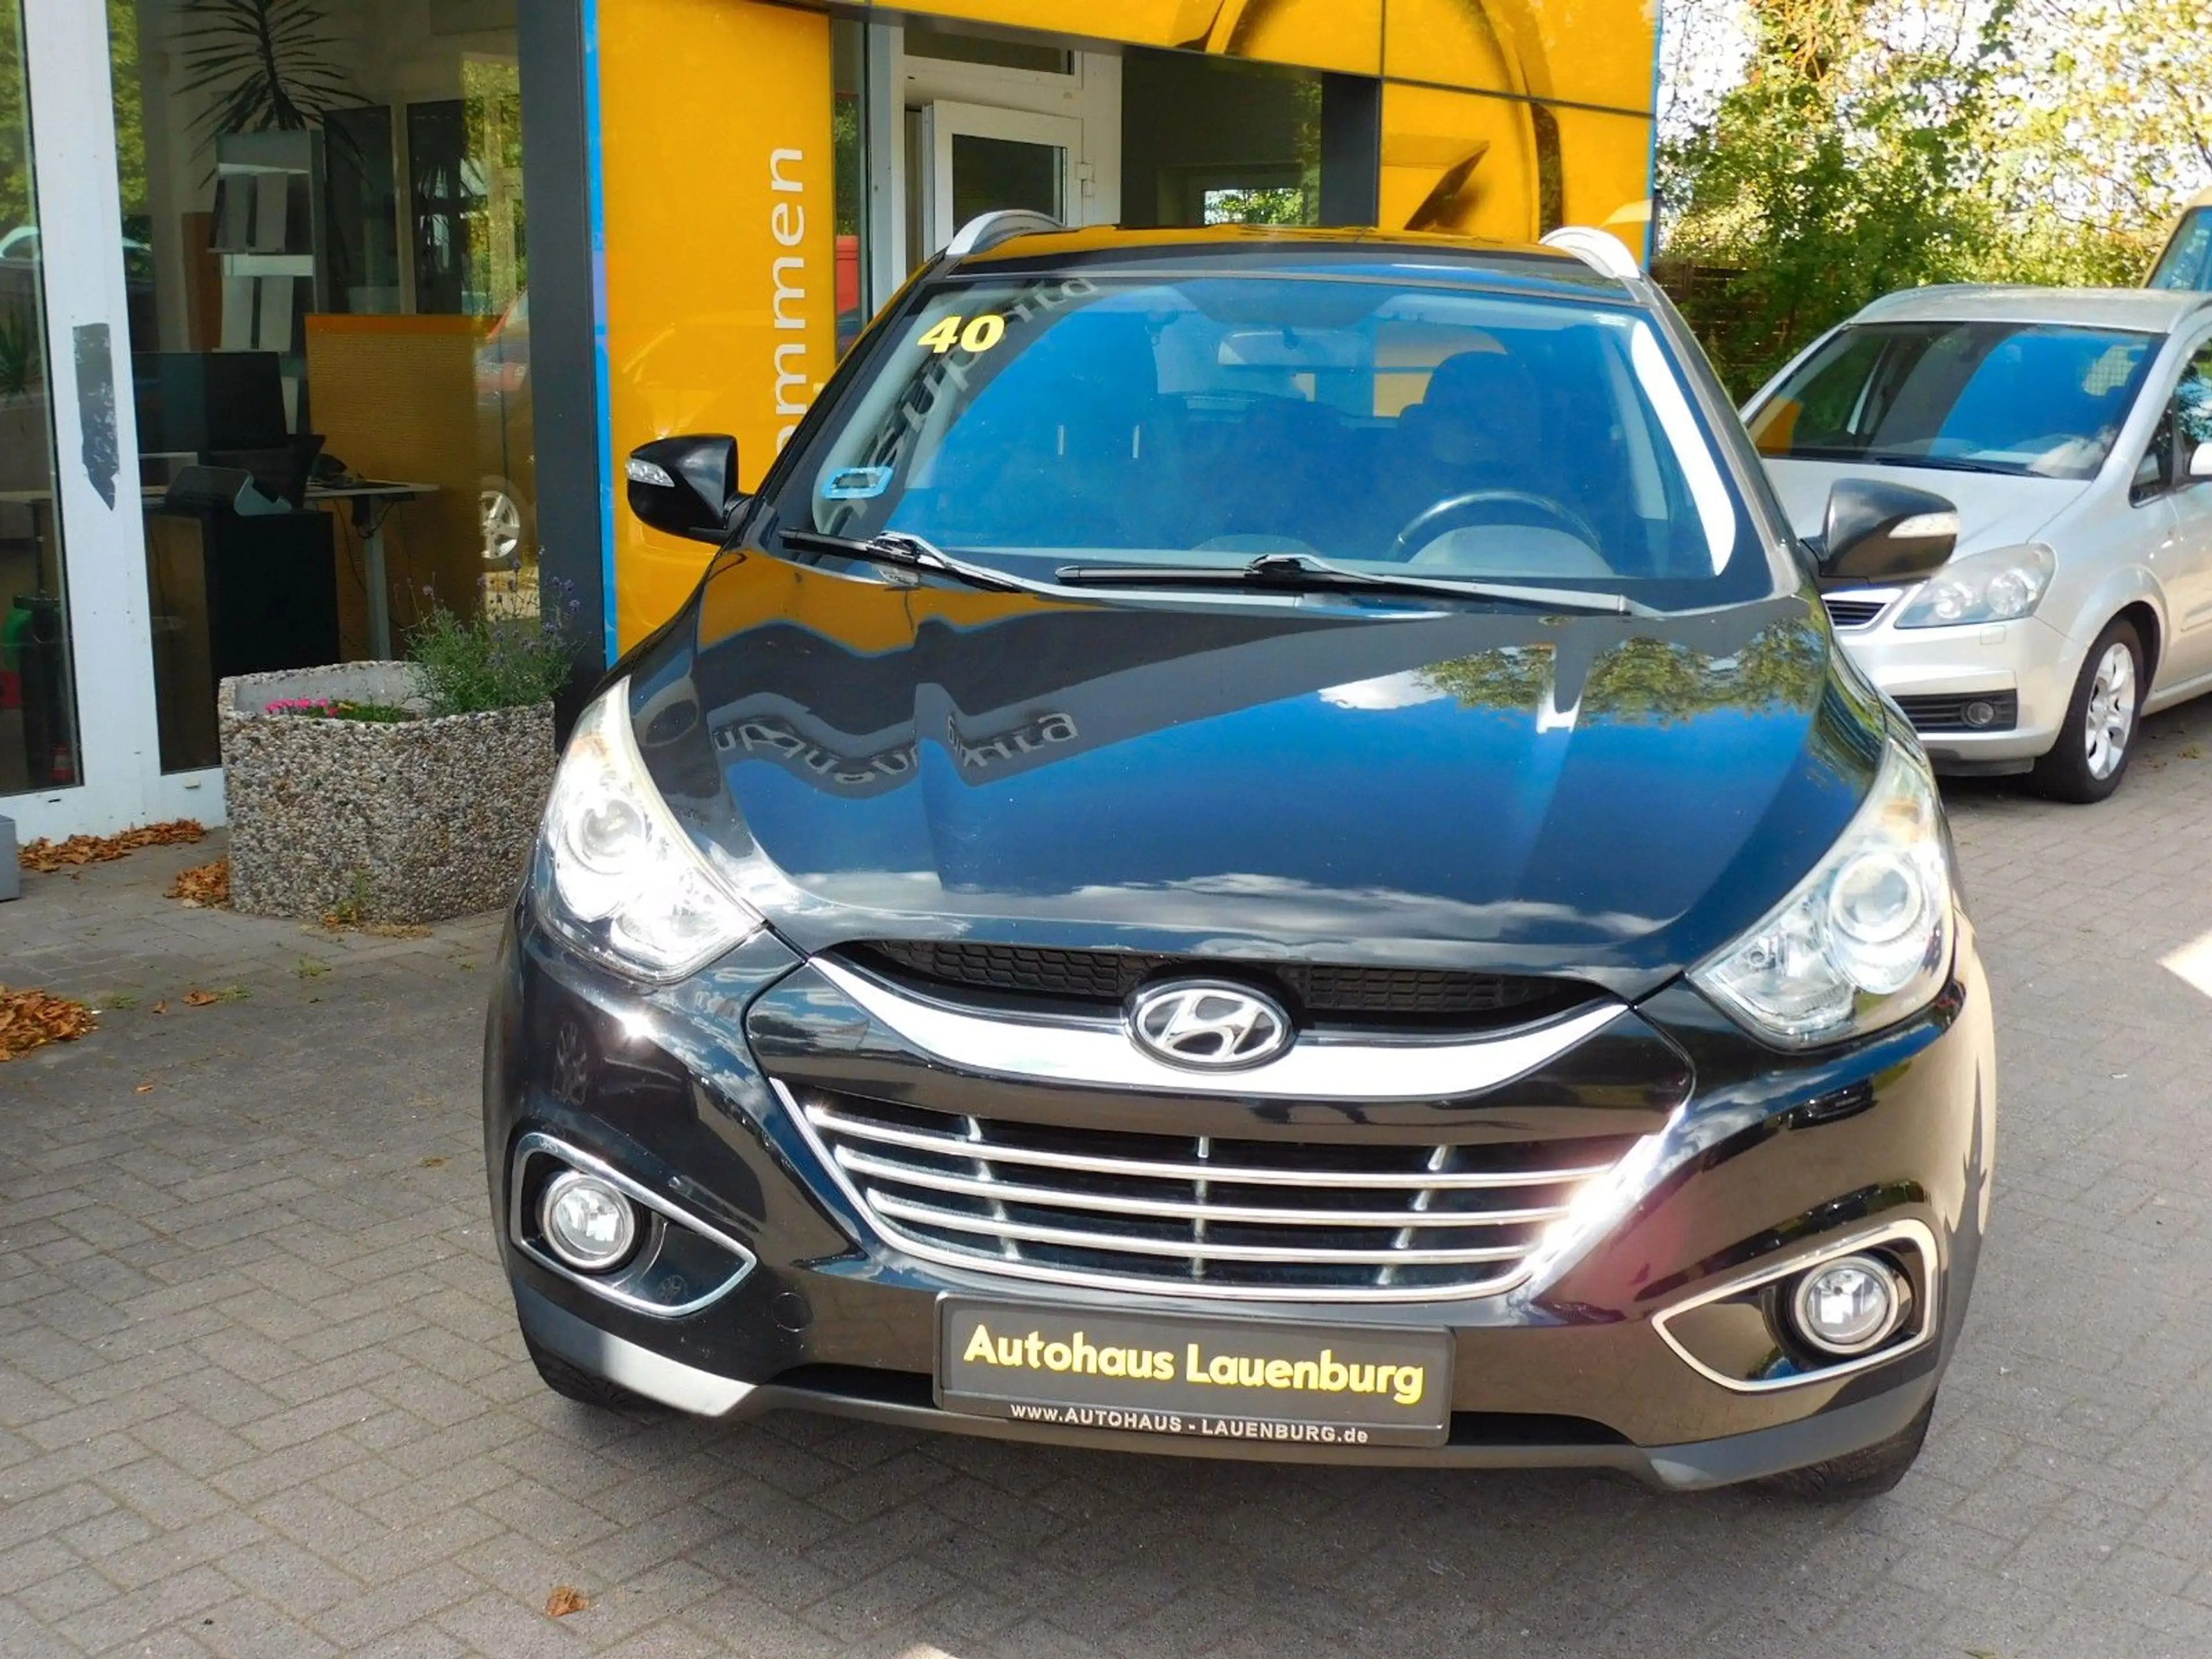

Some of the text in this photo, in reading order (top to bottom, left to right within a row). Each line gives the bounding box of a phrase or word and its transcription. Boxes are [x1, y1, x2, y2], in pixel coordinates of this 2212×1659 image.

[917, 315, 1005, 353] 40
[963, 1324, 1424, 1404] Autohaus Lauenburg
[1202, 1418, 1369, 1443] LAUENBURG.de
